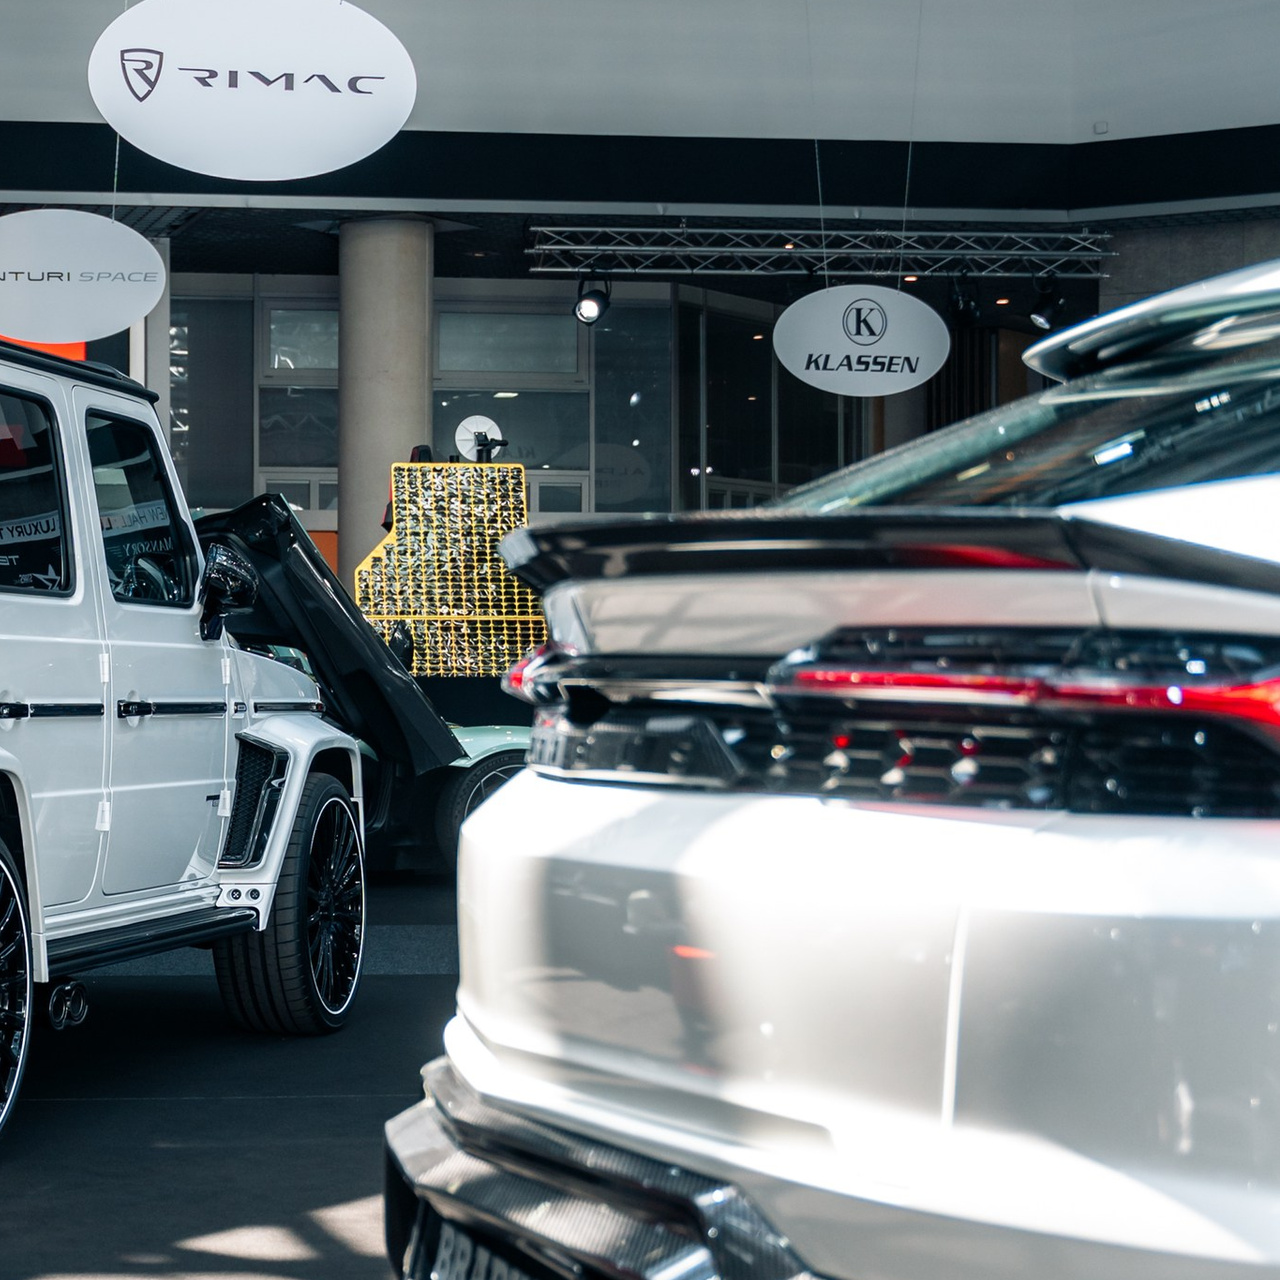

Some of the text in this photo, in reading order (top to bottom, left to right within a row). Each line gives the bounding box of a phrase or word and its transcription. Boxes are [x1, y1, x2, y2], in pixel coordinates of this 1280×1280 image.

[177, 67, 386, 95] RIMAC
[78, 271, 159, 282] SPACE
[804, 353, 920, 374] KLASSEN
